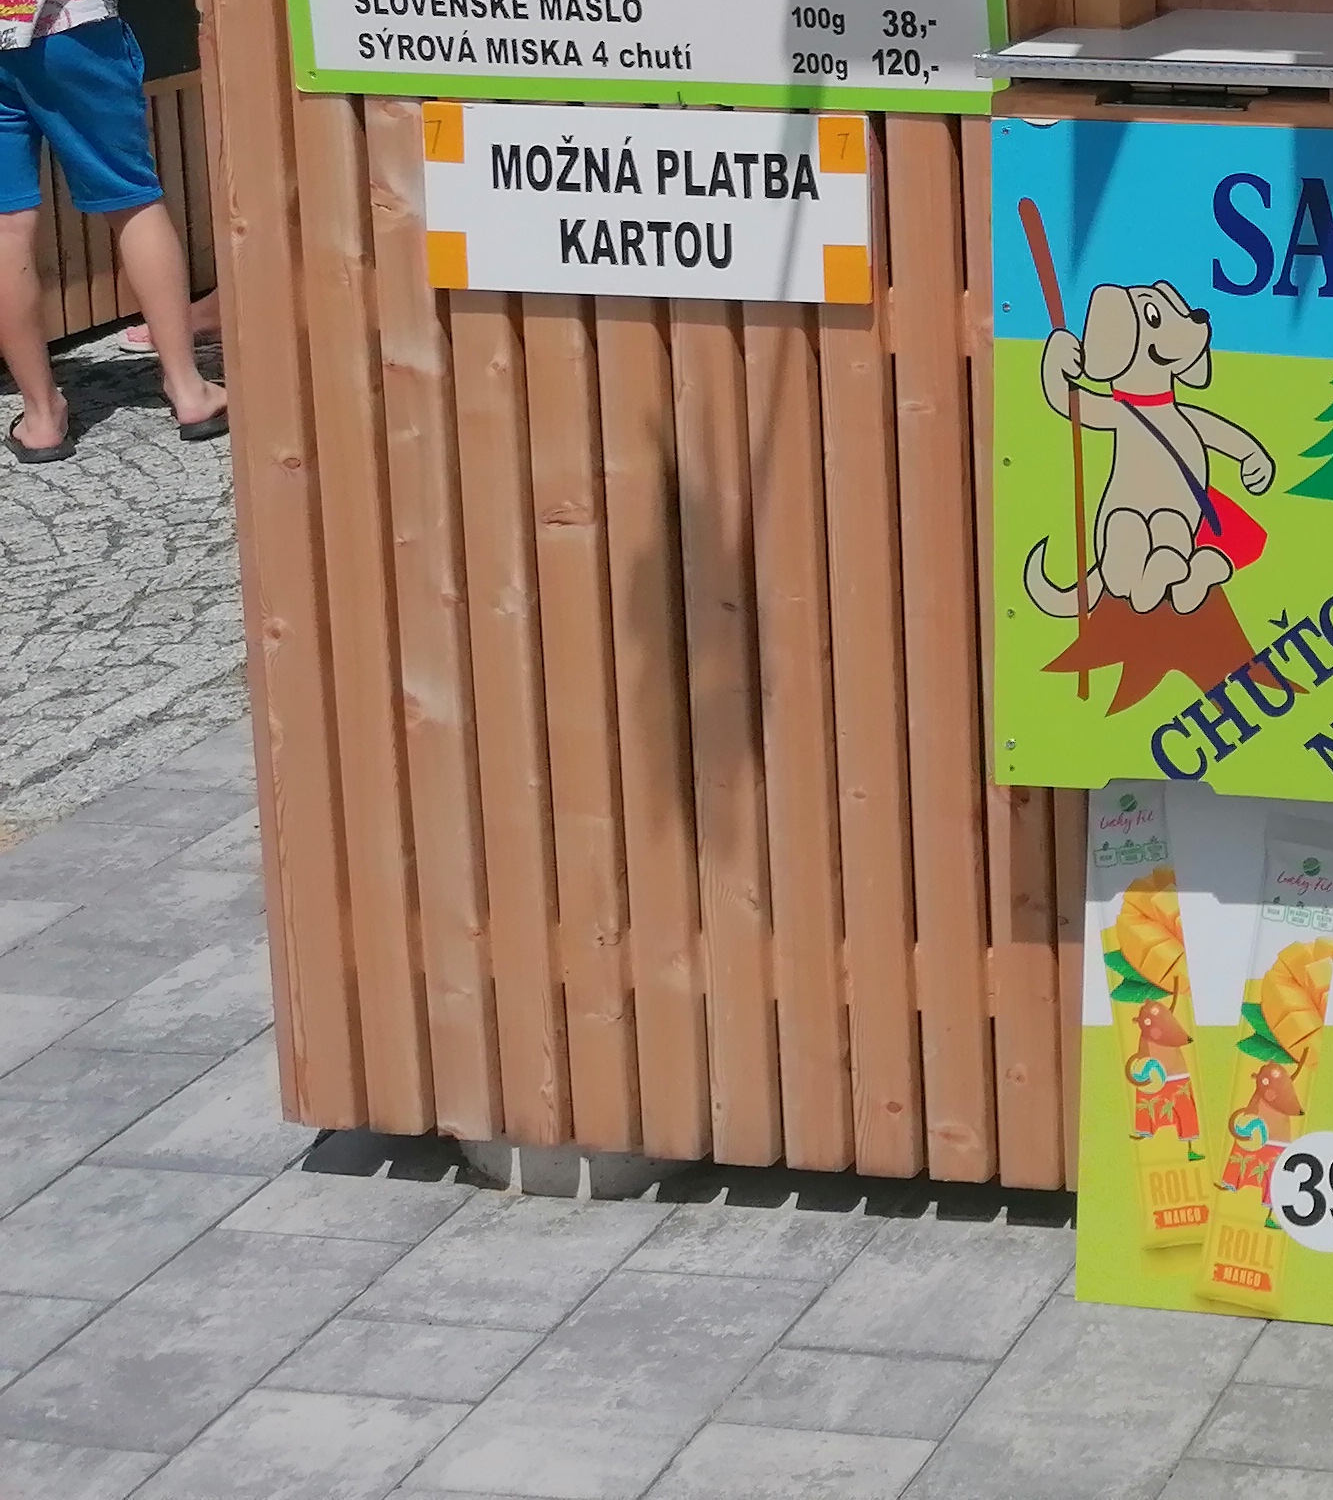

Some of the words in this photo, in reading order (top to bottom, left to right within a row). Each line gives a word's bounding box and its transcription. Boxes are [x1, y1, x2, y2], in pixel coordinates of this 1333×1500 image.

[791, 7, 846, 36] 100g
[882, 9, 937, 39] 38,-
[359, 27, 477, 63] SÝROVÁ
[486, 37, 583, 67] MISKA
[591, 40, 609, 67] 4
[619, 42, 692, 70] chutí
[792, 52, 848, 81] 200g
[871, 47, 940, 84] 120,-
[490, 135, 643, 195] MOŽNÁ
[657, 149, 820, 201] PLATBA
[560, 217, 733, 269] KARTOU
[1162, 1207, 1203, 1226] MANGO
[1222, 1266, 1262, 1288] MANGO
